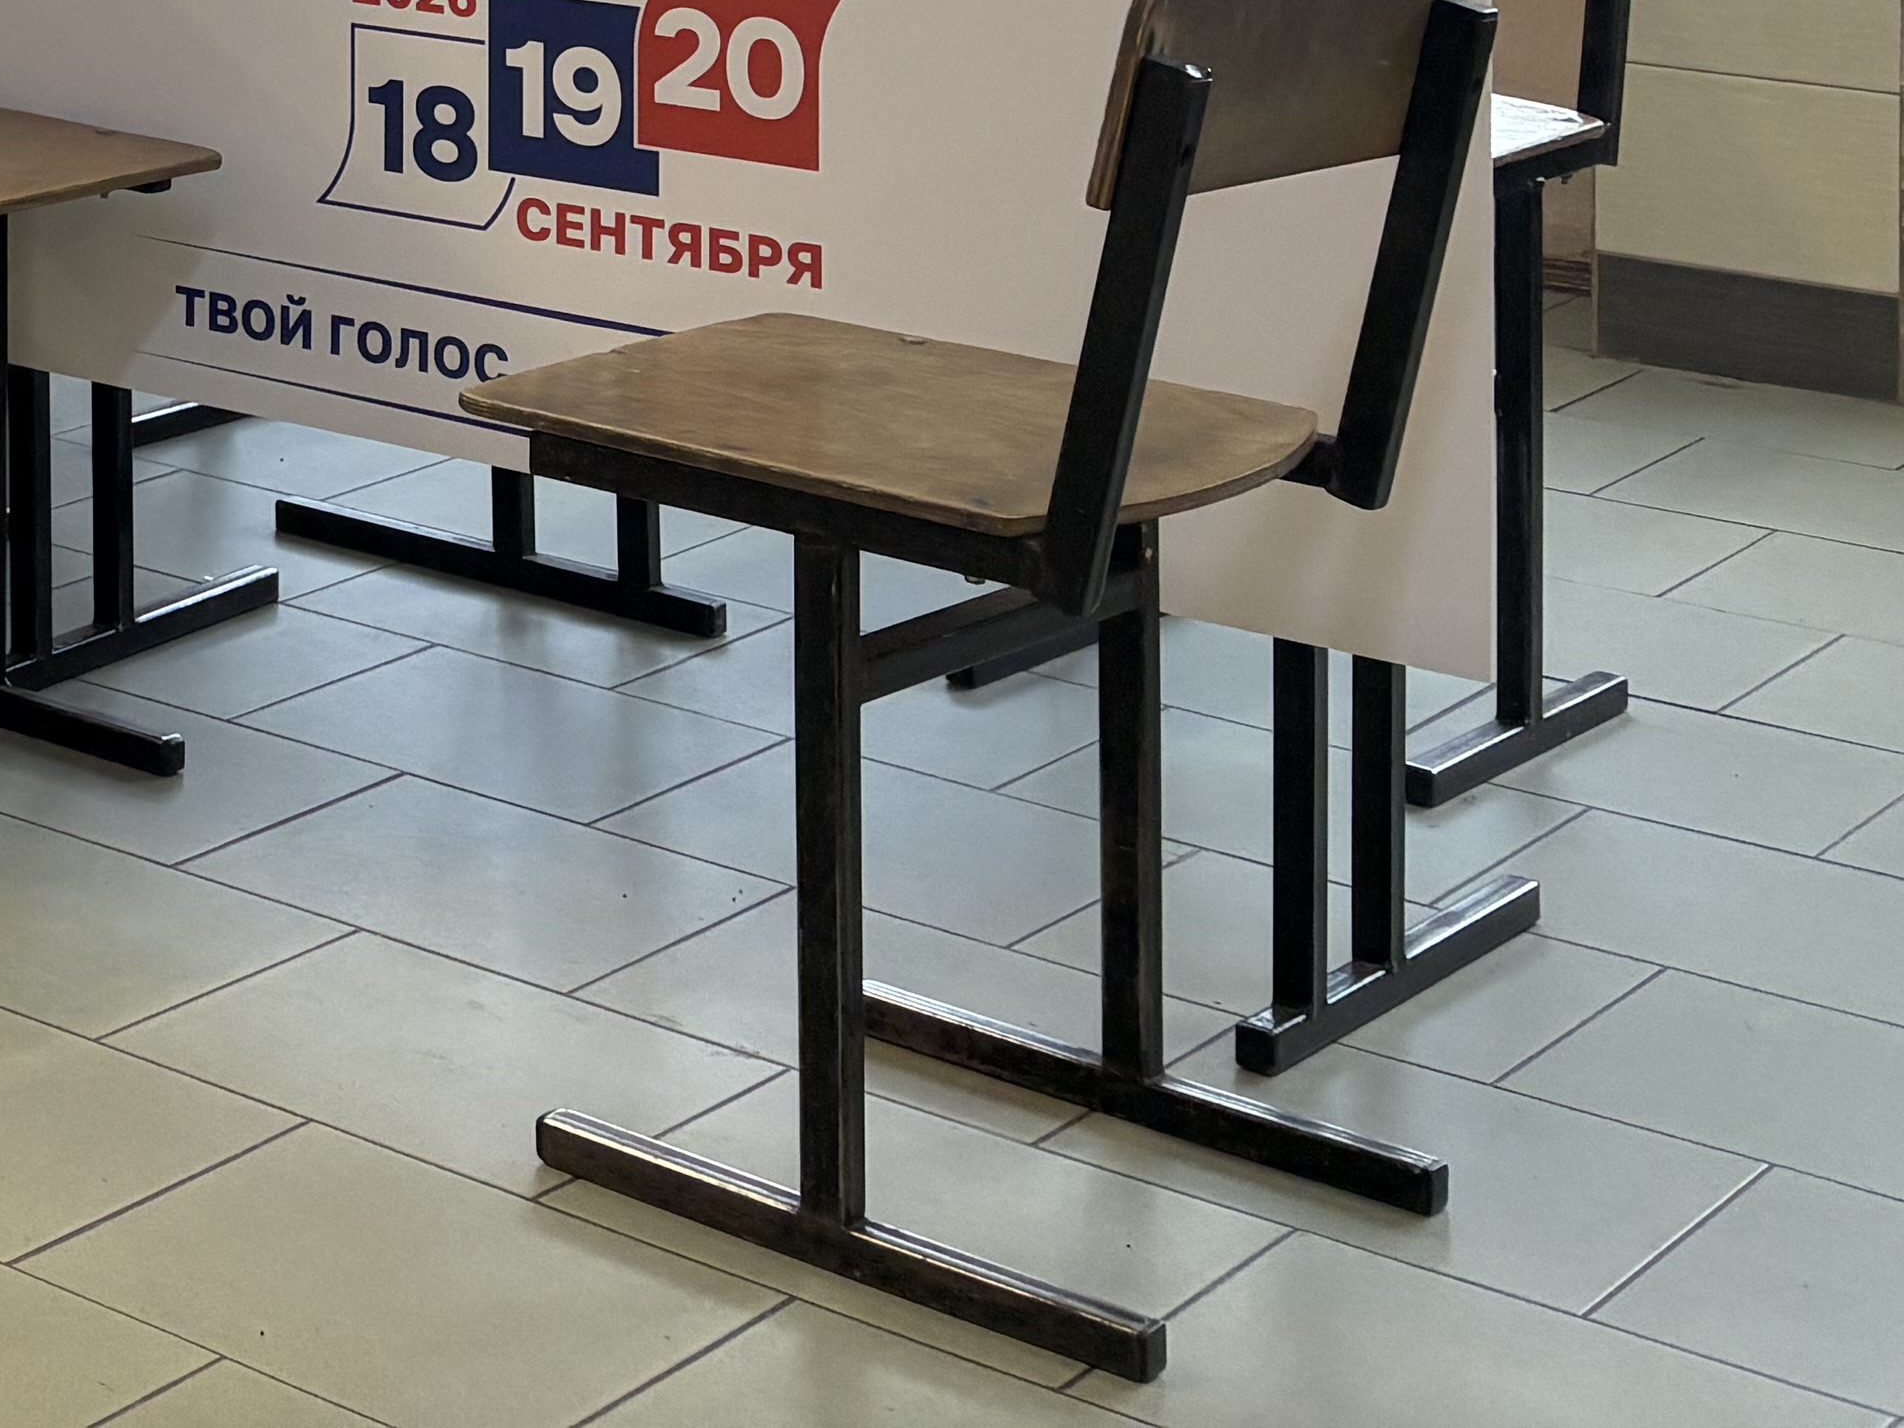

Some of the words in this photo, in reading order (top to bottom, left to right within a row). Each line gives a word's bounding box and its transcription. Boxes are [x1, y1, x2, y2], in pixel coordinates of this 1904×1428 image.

[368, 78, 478, 182] 18
[505, 40, 622, 147] 19
[654, 7, 806, 120] 20
[515, 197, 823, 289] СЕНТЯБРЯ
[175, 285, 313, 351] ТВОЙ
[331, 315, 509, 383] ГОЛОС
